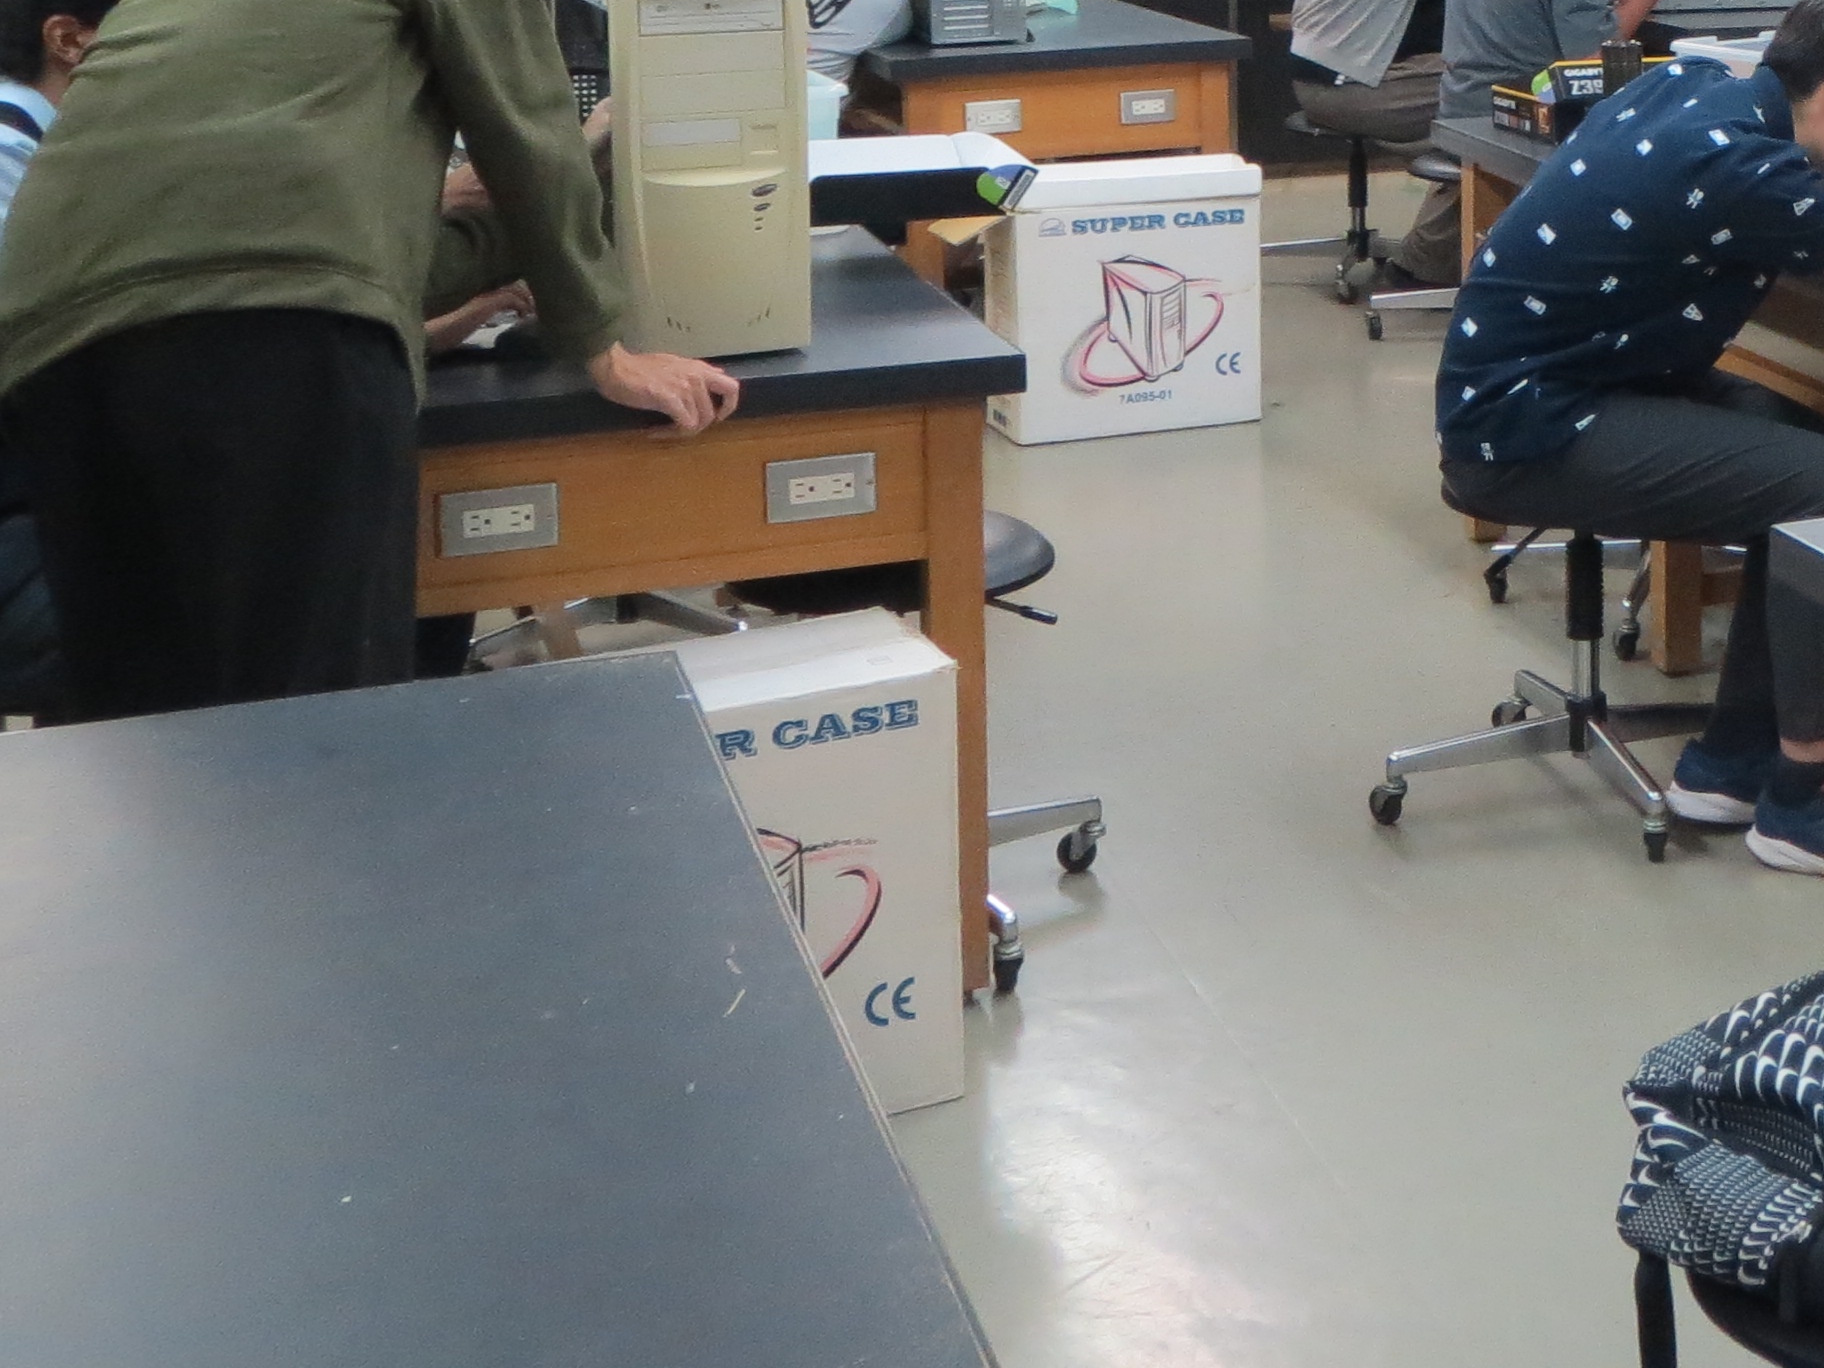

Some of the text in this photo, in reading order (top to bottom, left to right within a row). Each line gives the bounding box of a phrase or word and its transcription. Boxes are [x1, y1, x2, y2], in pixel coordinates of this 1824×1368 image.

[1072, 209, 1245, 234] SUPER CASE
[1215, 351, 1241, 375] CE
[772, 699, 919, 749] CASE
[865, 976, 917, 1028] CE
